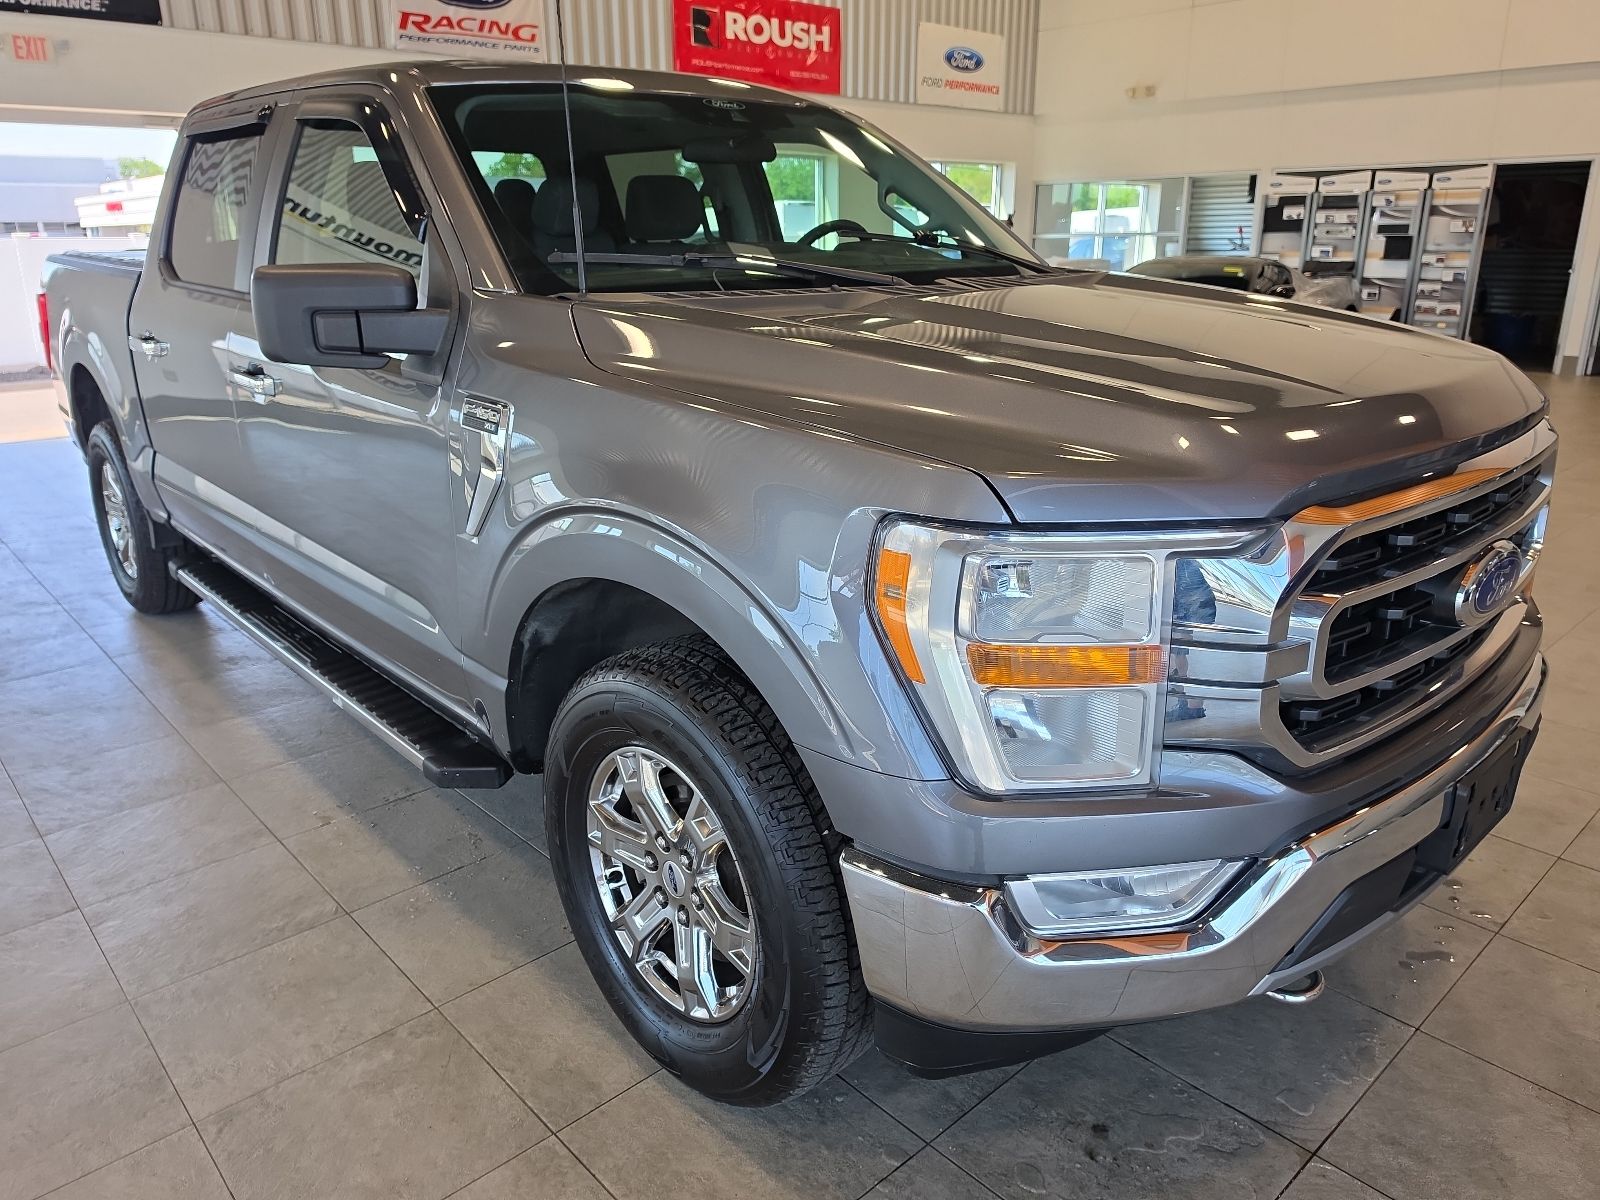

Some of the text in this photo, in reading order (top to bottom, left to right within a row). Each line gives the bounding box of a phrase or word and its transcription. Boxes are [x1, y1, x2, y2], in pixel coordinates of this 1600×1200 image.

[399, 11, 539, 43] RACING
[725, 11, 831, 52] ROUSH
[12, 34, 48, 61] EXIT
[400, 34, 541, 54] PERFORMANCE PARTS
[921, 76, 1000, 95] FORD PERFORMANCE
